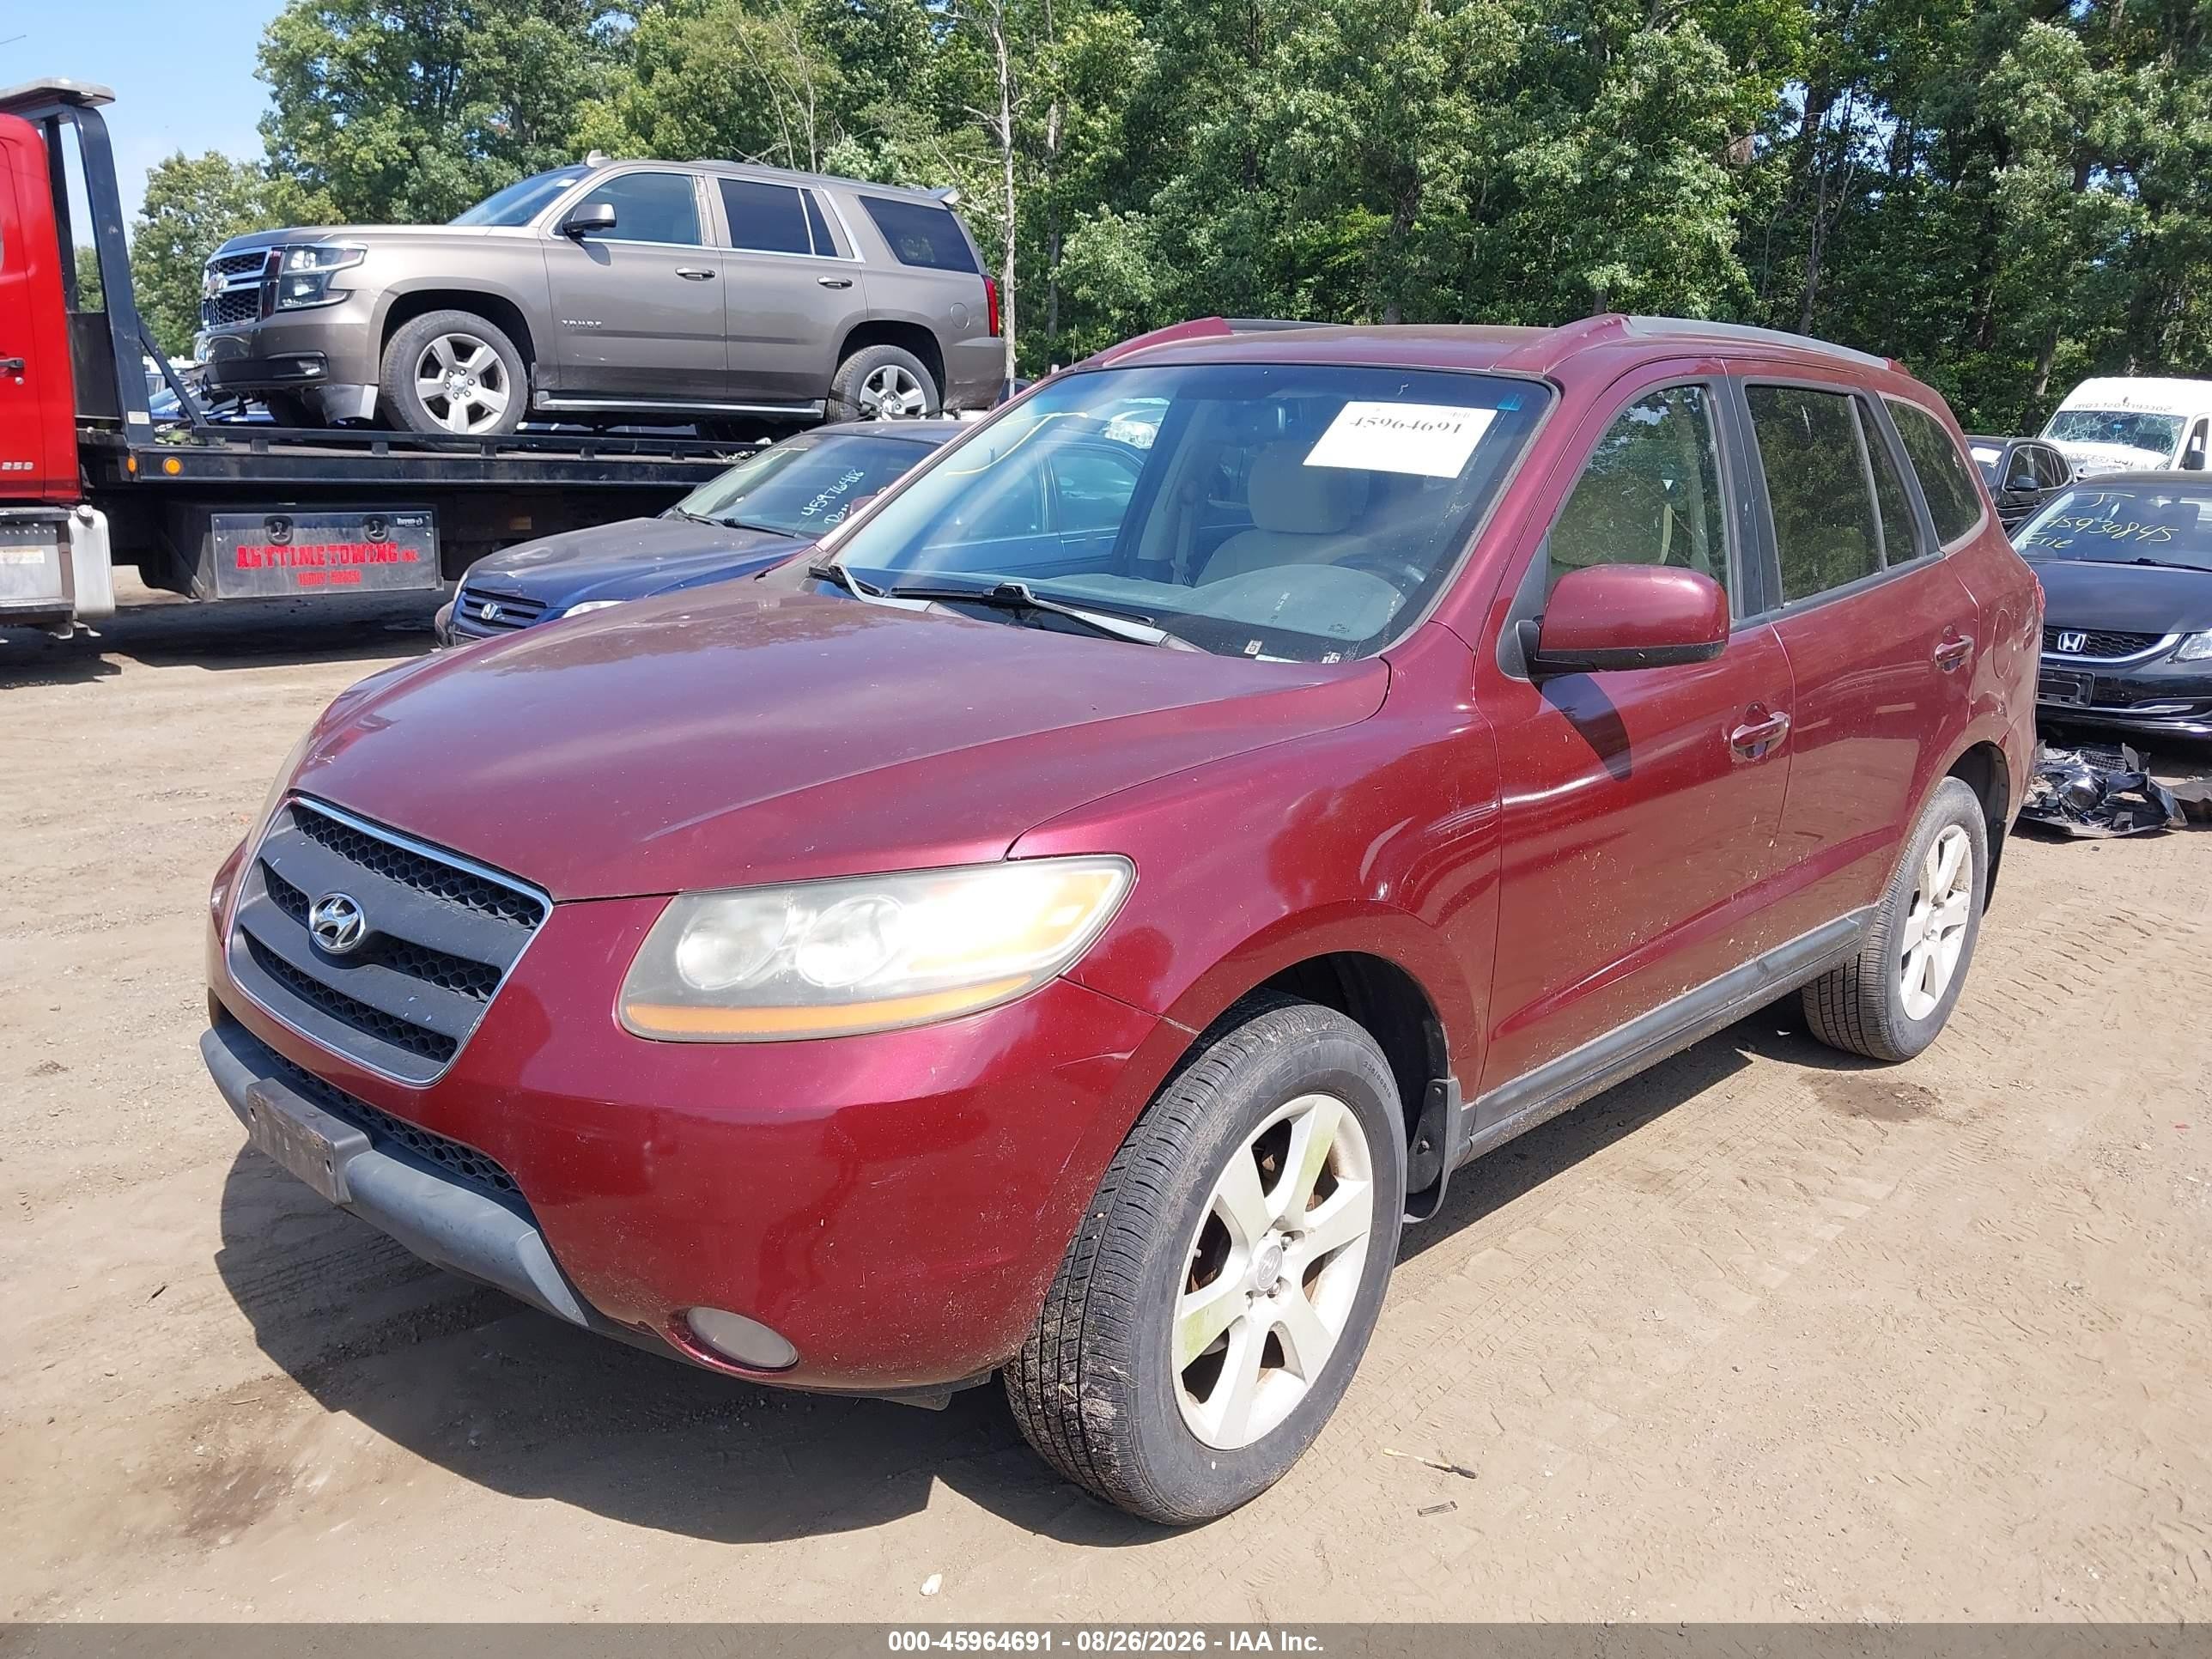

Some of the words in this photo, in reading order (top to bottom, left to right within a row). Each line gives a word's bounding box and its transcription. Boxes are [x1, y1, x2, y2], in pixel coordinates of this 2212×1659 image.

[1349, 416, 1462, 434] 45964691
[2045, 514, 2179, 542] 45930845
[2025, 532, 2074, 549] Erie
[236, 545, 325, 568] ANYTIME
[329, 543, 398, 565] TOWING
